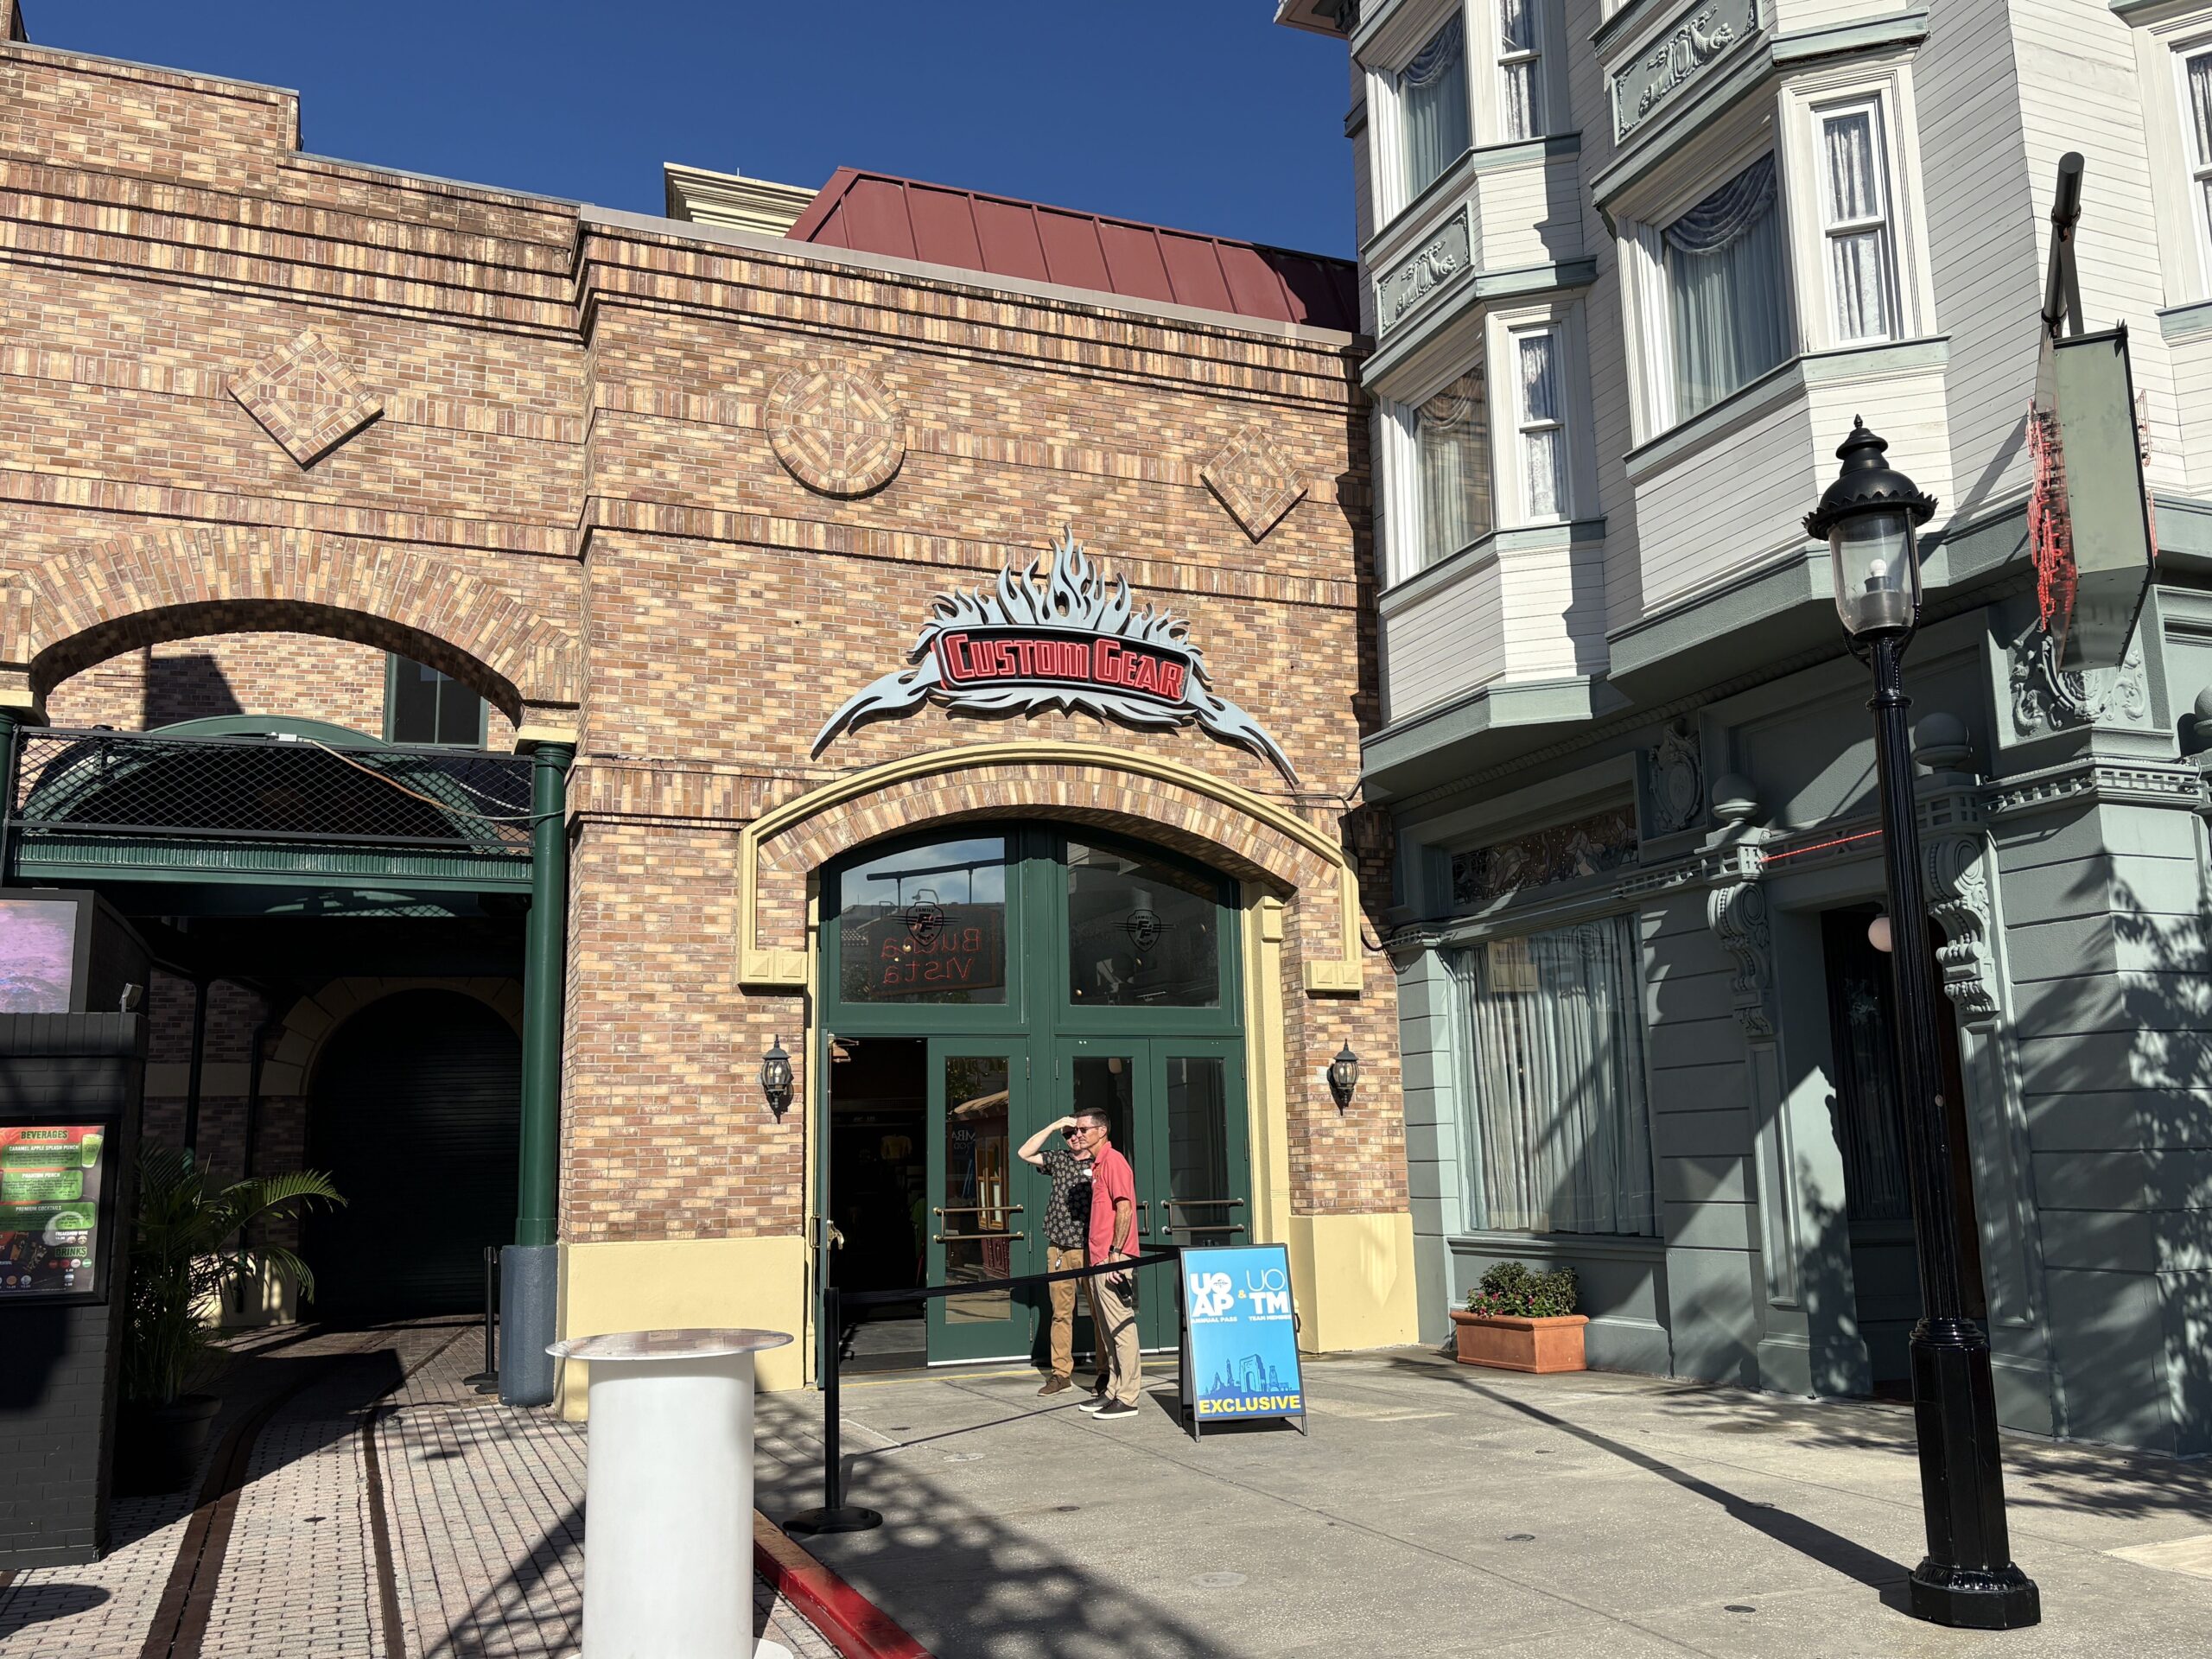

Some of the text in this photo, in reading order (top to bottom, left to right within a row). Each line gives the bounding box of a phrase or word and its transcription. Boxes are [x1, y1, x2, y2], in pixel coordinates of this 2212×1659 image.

[1093, 638, 1185, 700] GEAR
[21, 1130, 68, 1140] BEVERAGES
[55, 1247, 87, 1257] DRINKS
[1190, 1272, 1232, 1294] UO
[1246, 1268, 1285, 1291] UO
[1192, 1293, 1235, 1317] AP
[1237, 1289, 1247, 1299] &
[1249, 1291, 1289, 1314] TM
[1198, 1395, 1301, 1414] EXCLUSIVE
